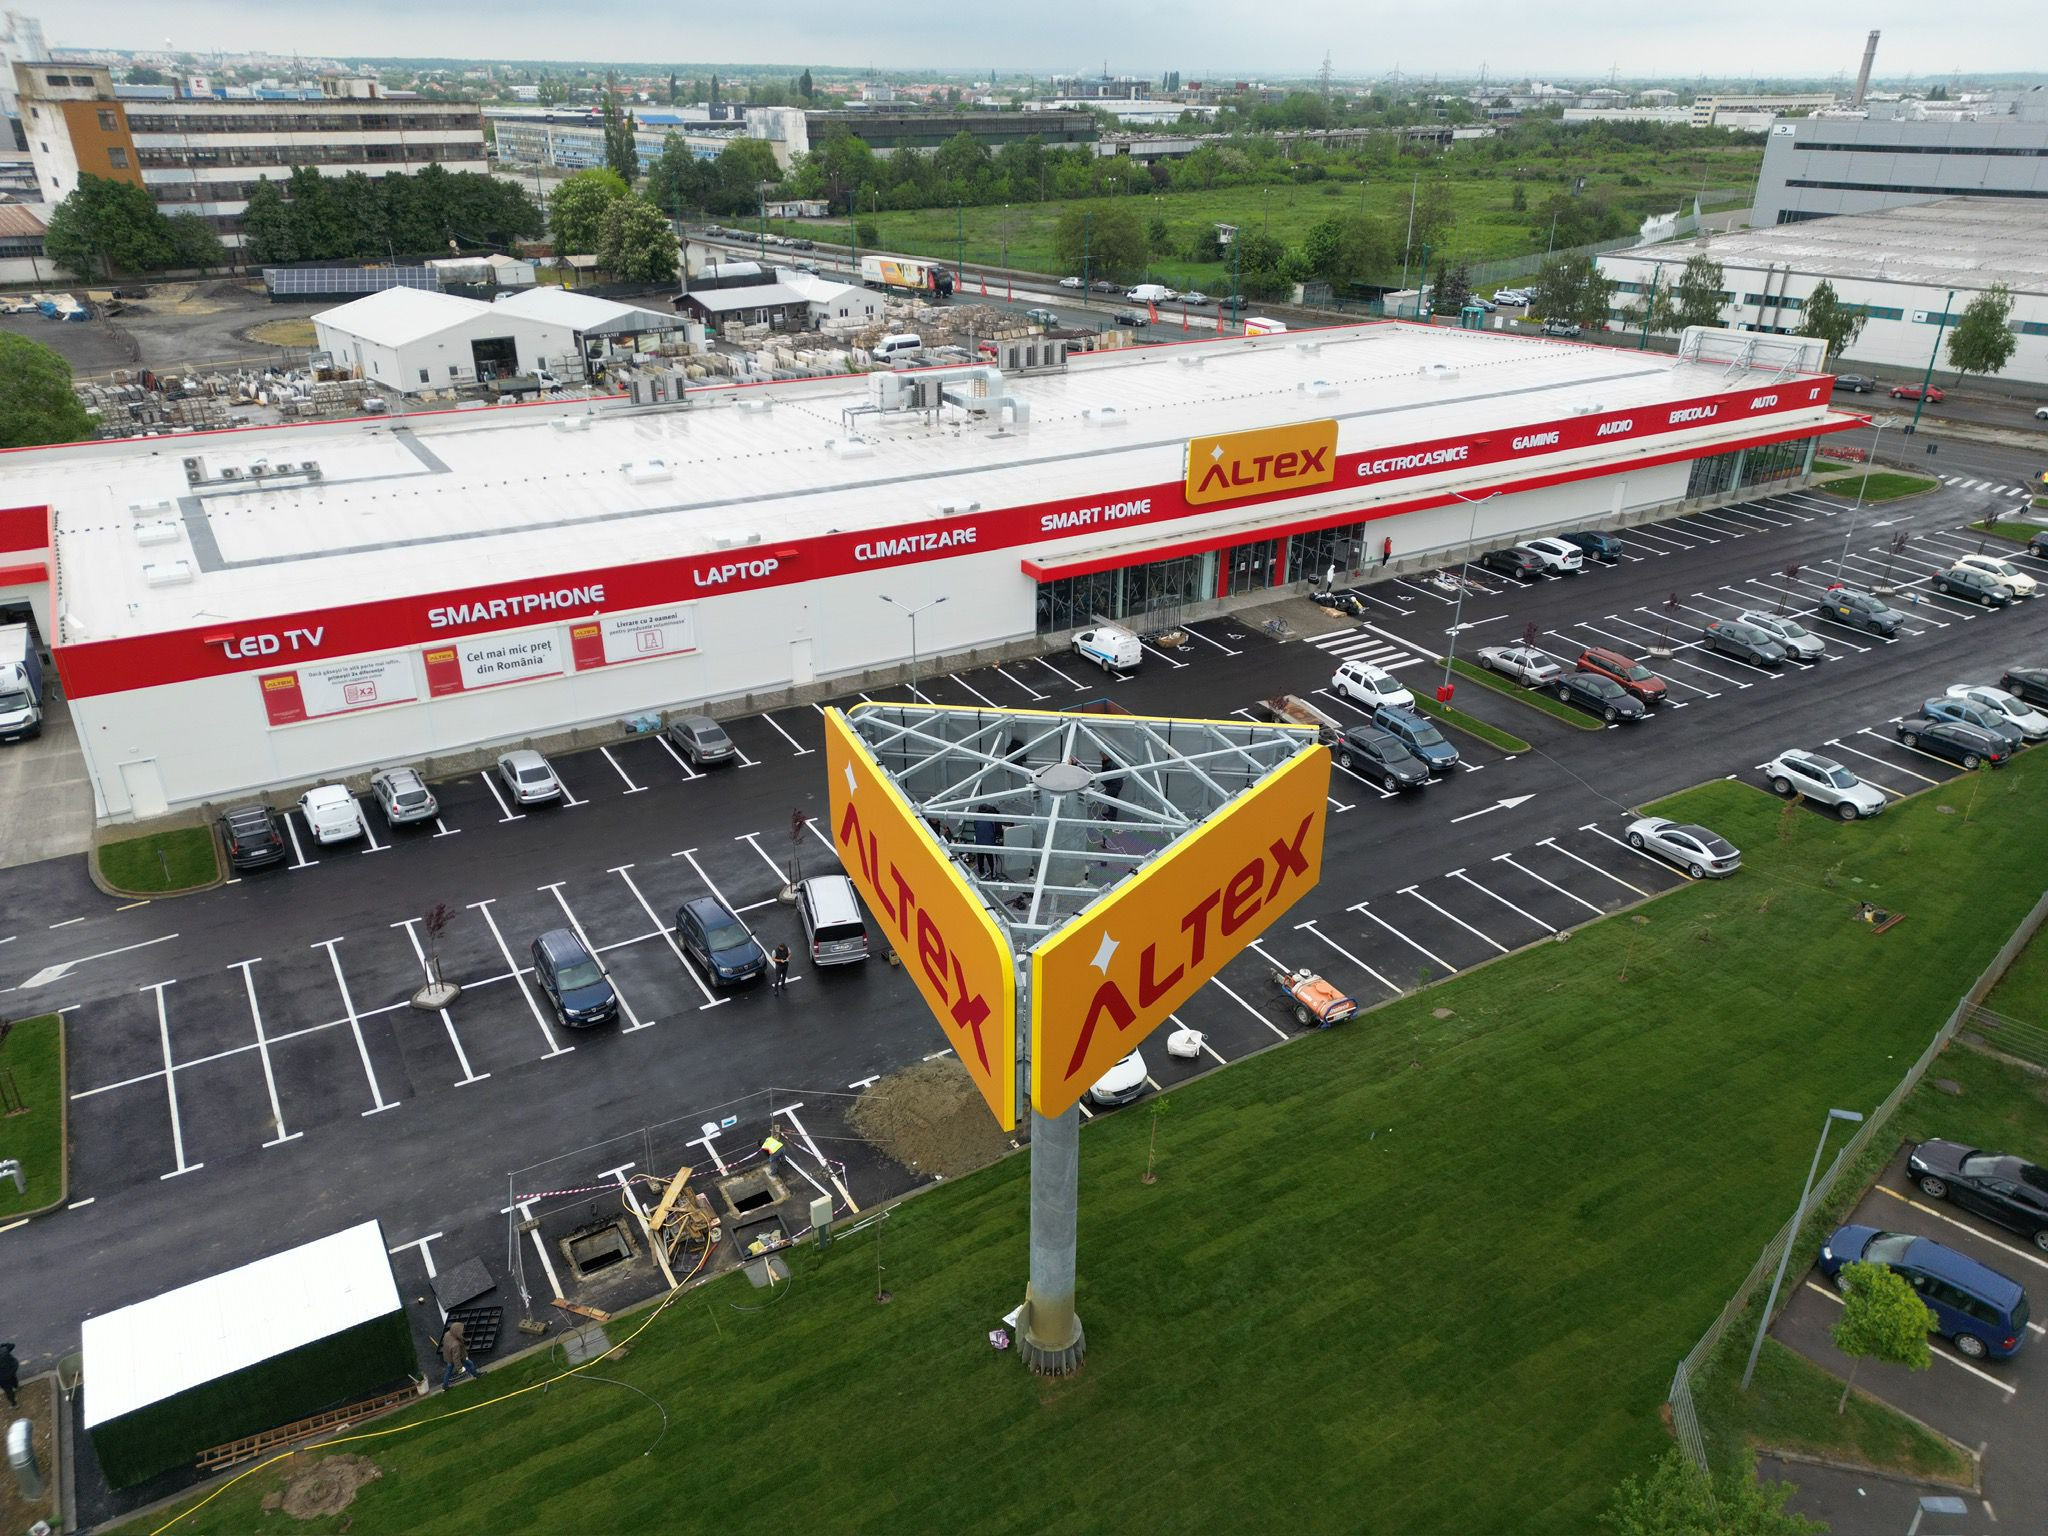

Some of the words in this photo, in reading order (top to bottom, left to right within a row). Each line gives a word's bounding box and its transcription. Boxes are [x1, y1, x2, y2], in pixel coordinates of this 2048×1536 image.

[1750, 394, 1778, 410] AUTO
[1809, 387, 1821, 400] IT
[1669, 404, 1718, 424] BRICOLAJ
[1597, 419, 1633, 436] AUDIO
[1512, 431, 1559, 450] GAMING
[1357, 446, 1468, 477] ELECTROCASNICE
[1041, 507, 1102, 531] SMART
[1104, 498, 1151, 521] HOME
[854, 527, 977, 561] CLIMATIZARE
[693, 558, 778, 587] LAPTOP
[428, 584, 605, 628] SMARTPHONE
[616, 619, 639, 628] Livrare
[654, 612, 678, 622] oameni
[223, 634, 280, 659] LED
[283, 626, 324, 650] TV
[467, 651, 484, 662] Cel
[486, 647, 506, 659] mai
[509, 643, 528, 655] mic
[530, 640, 552, 653] preț
[476, 664, 494, 674] din
